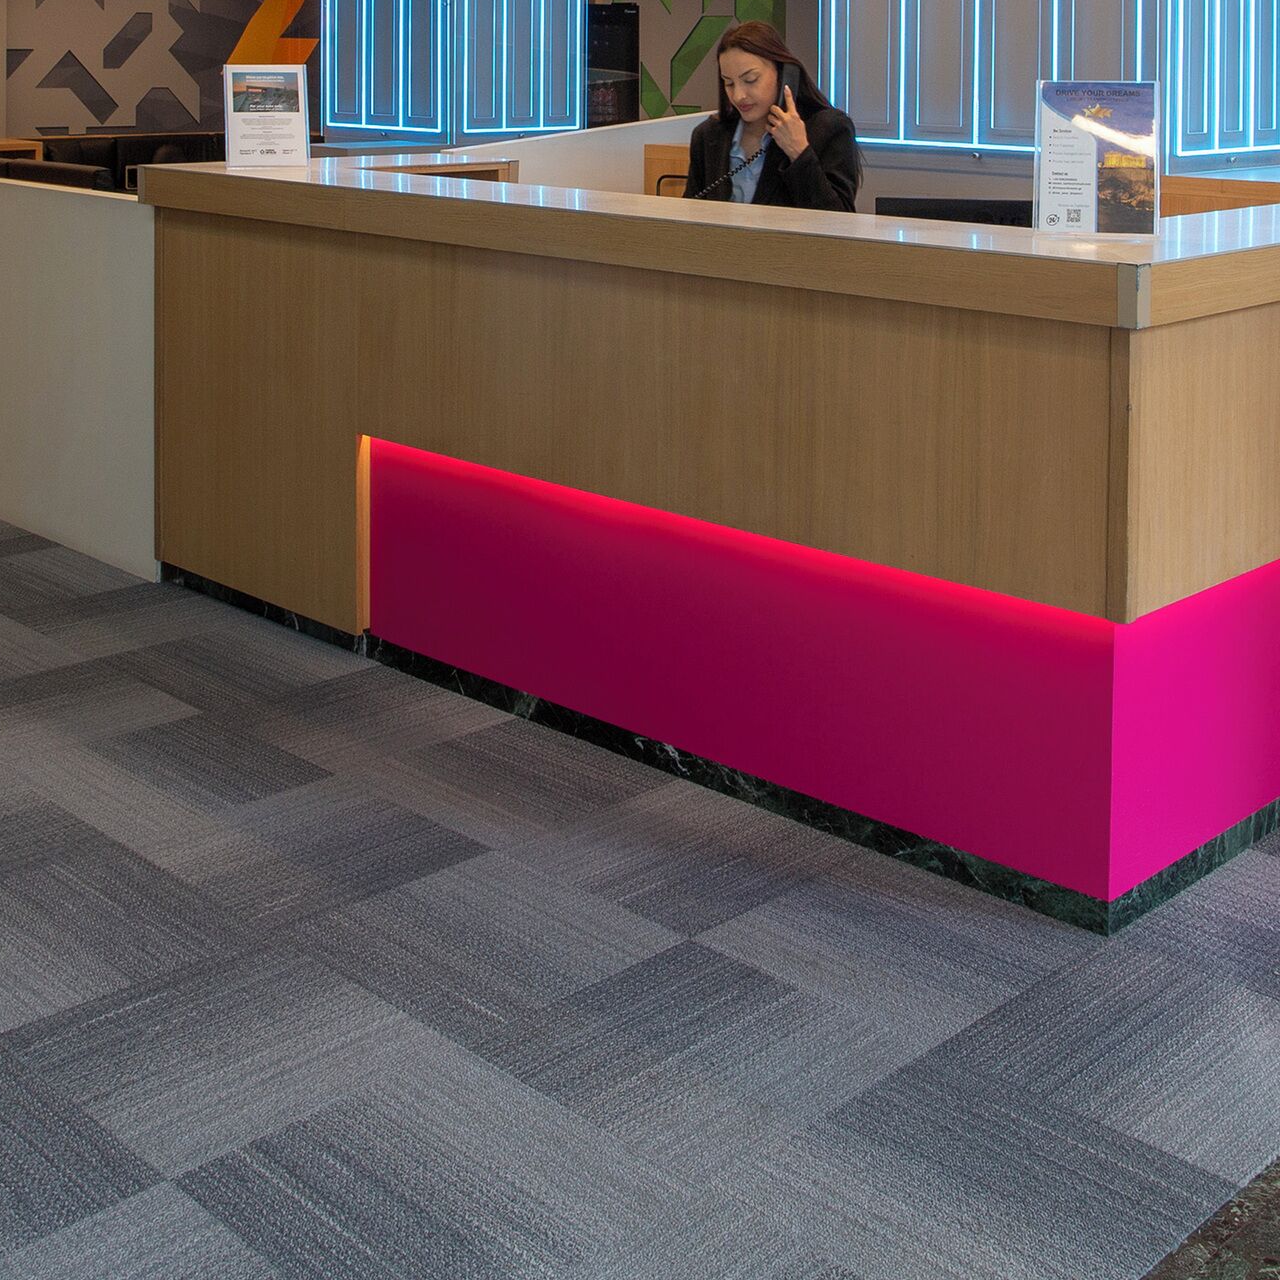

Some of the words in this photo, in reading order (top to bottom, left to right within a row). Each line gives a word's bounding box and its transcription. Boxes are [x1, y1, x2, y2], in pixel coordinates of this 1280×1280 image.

[1055, 89, 1080, 97] DRIVE
[1081, 89, 1105, 97] YOUR
[1106, 89, 1141, 98] DREAMS
